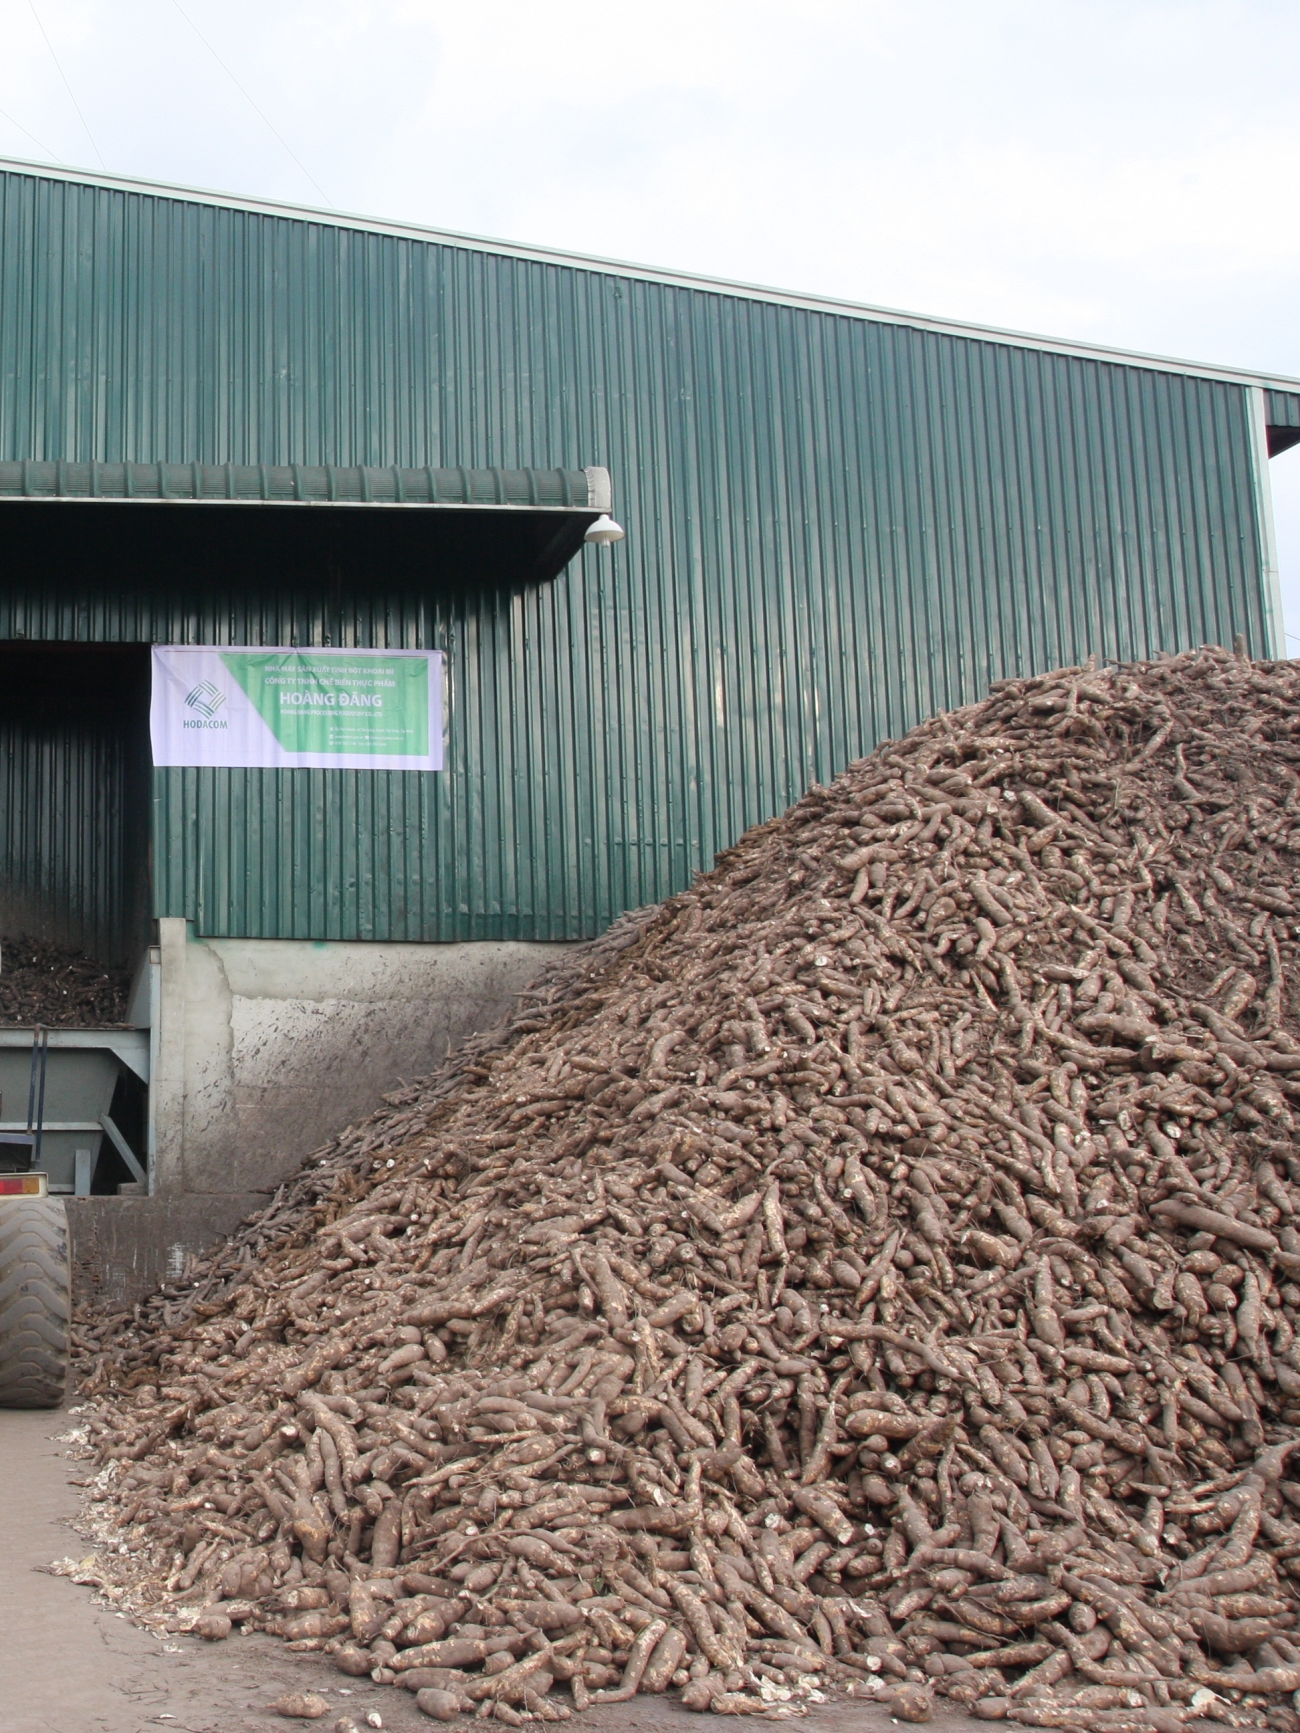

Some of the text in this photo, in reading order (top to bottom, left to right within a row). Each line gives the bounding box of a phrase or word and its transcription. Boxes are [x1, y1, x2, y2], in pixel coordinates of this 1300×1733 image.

[265, 676, 286, 684] CÔNG
[287, 677, 297, 685] TY
[319, 677, 334, 686] CHẾ
[334, 677, 351, 686] BIẾN
[352, 679, 373, 688] THỰC
[281, 691, 382, 707] HOÀNG ĐĂNG
[183, 720, 228, 729] HODACOM
